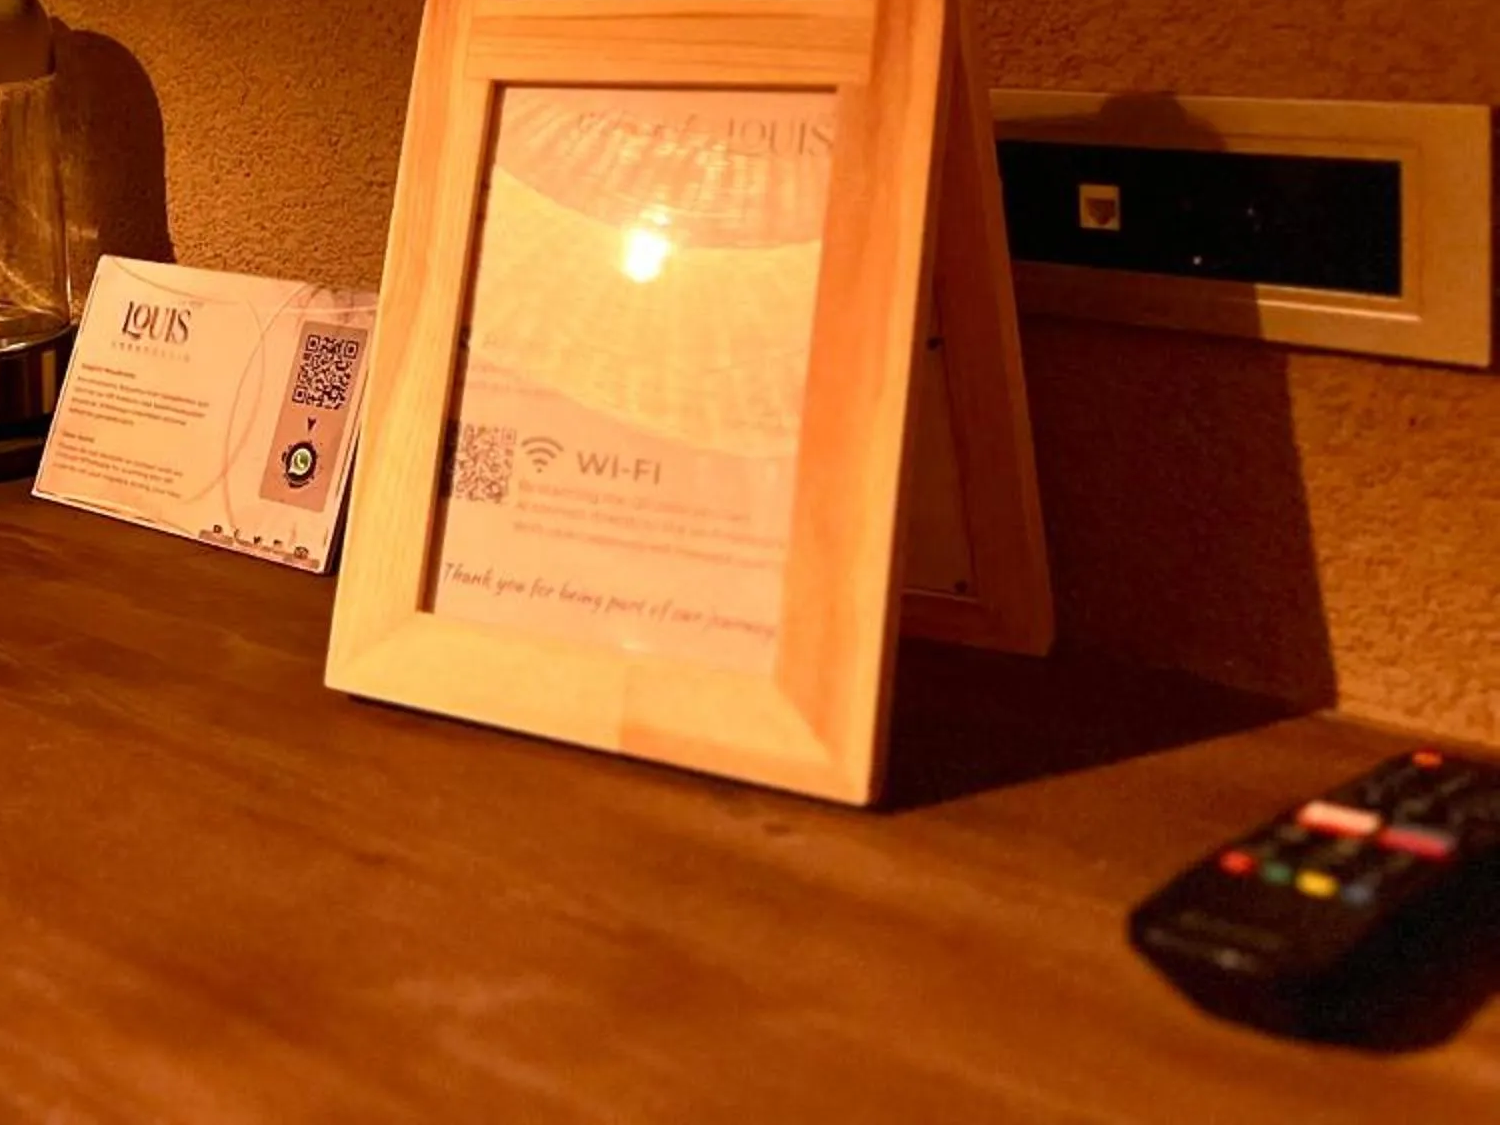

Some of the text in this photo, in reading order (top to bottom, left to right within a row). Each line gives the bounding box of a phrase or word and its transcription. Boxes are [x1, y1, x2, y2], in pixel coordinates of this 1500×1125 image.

[120, 299, 192, 346] LOUIS
[576, 450, 662, 485] WI-FI
[443, 562, 493, 590] Thank
[494, 576, 525, 597] you
[529, 576, 556, 600] for
